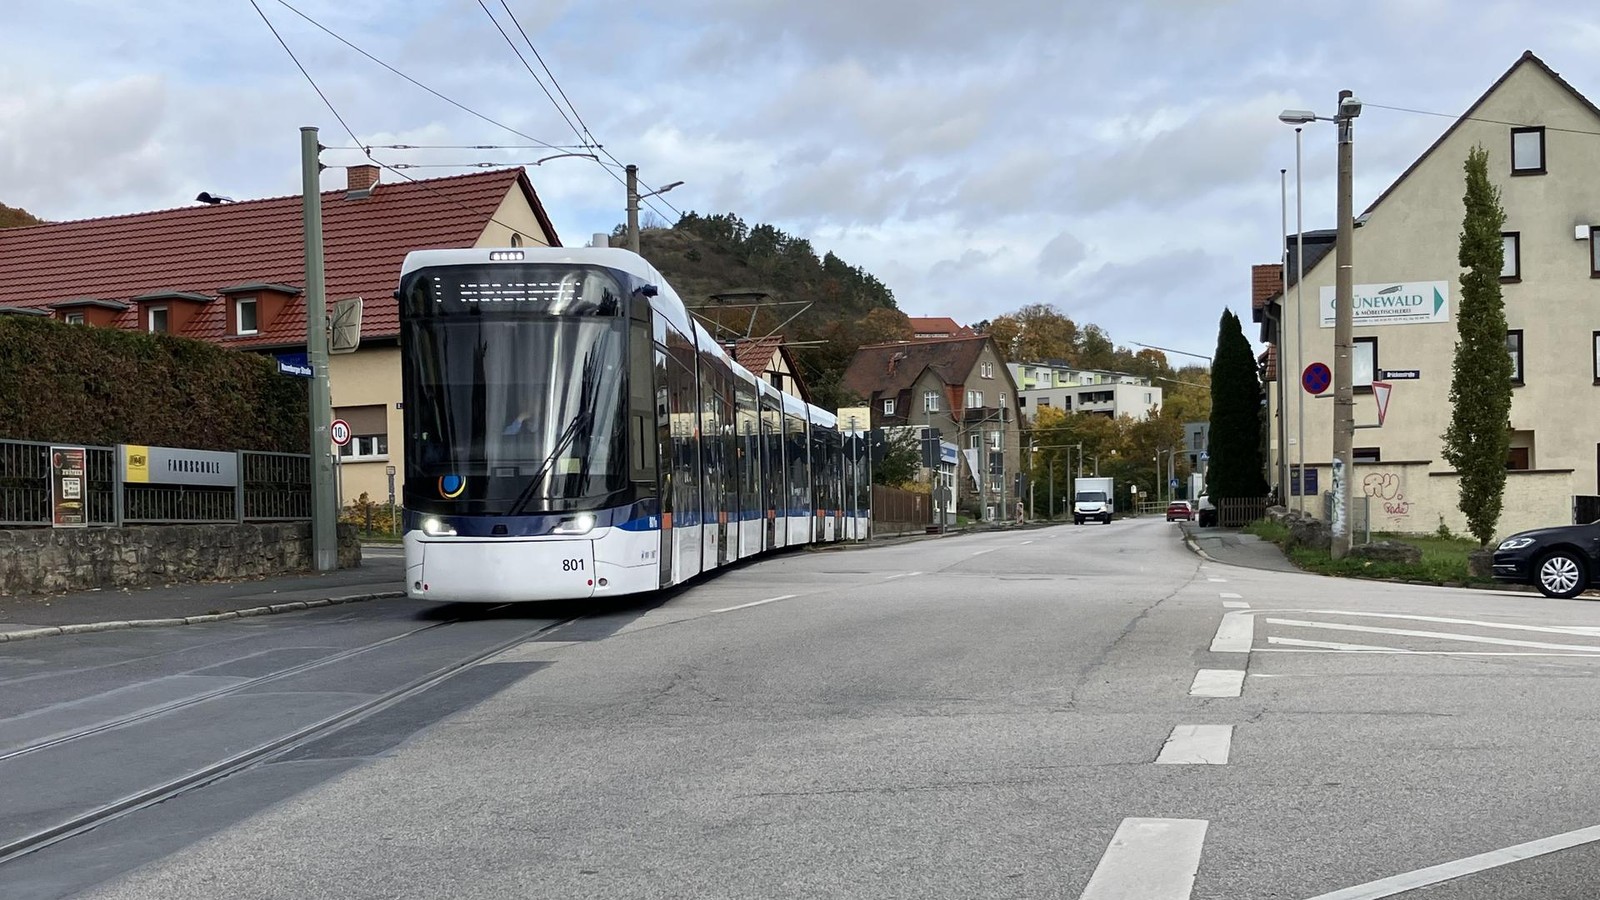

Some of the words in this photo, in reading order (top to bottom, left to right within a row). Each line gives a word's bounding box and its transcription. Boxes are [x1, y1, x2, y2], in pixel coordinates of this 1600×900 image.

[334, 427, 342, 438] 10
[168, 459, 220, 474] FAHRSCHULE
[563, 559, 585, 571] 801
